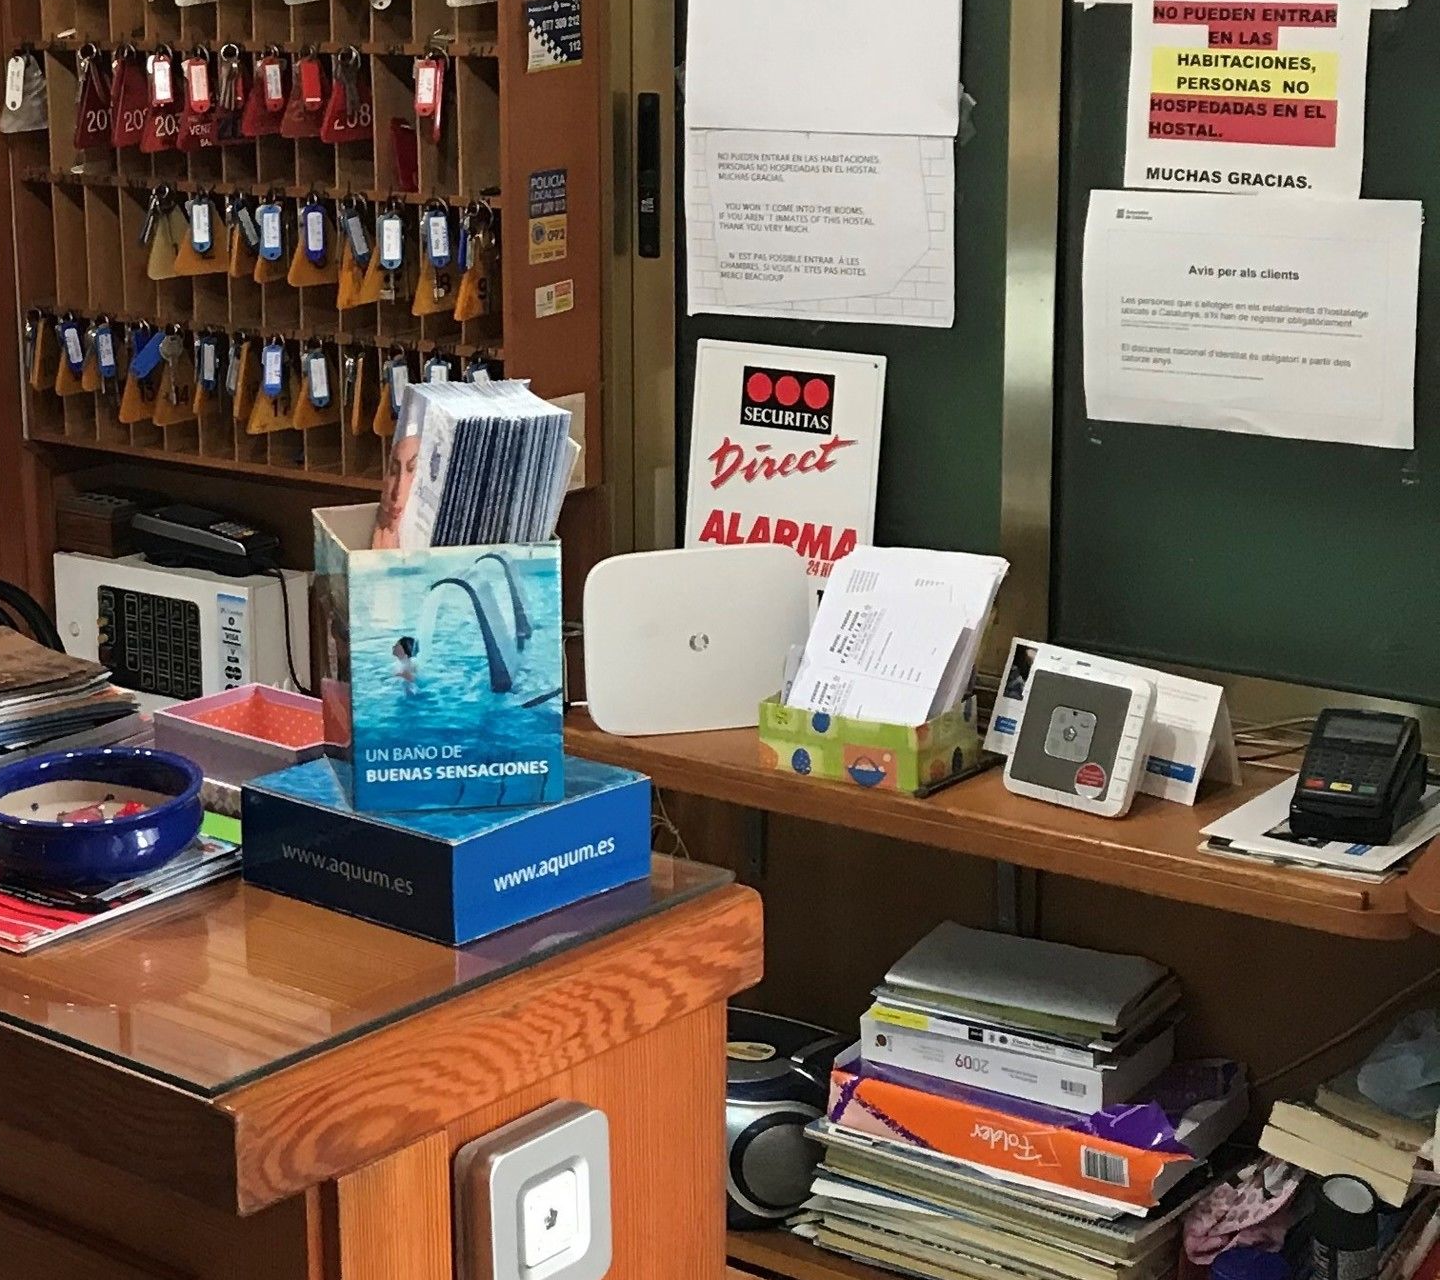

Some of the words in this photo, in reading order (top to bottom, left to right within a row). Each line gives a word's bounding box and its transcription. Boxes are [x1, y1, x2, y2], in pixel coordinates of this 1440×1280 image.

[1154, 6, 1177, 19] NO
[1184, 7, 1256, 21] PUEDEN
[1262, 9, 1336, 23] ENTRAR
[569, 40, 581, 52] 112
[1209, 32, 1233, 44] EN
[1240, 32, 1272, 45] LAS
[1178, 54, 1316, 73] HABITACIONES,
[1177, 77, 1270, 92] PERSONAS
[1283, 81, 1309, 93] NO
[1151, 99, 1266, 115] HOSPEDADAS
[1273, 105, 1297, 117] EN
[1304, 106, 1326, 118] EL
[1150, 122, 1222, 137] HOSTAL.
[718, 152, 729, 160] NO
[761, 153, 790, 161] ENTRAR
[792, 154, 802, 162] EN
[770, 164, 819, 172] HOSPEDADAS
[1146, 168, 1221, 183] MUCHAS
[1228, 172, 1312, 189] GRACIAS.
[772, 204, 793, 212] COME
[746, 223, 760, 231] YOU
[1189, 266, 1214, 275] Avis
[1218, 268, 1236, 278] per
[1240, 269, 1256, 278] als
[1260, 270, 1299, 280] clients
[744, 407, 829, 430] SECURITAS
[708, 434, 858, 490] Direct
[699, 509, 857, 561] ALARMA
[225, 633, 239, 642] VISA
[365, 748, 389, 762] UN
[393, 744, 438, 761] BAÑO
[441, 745, 462, 759] DE
[366, 766, 432, 783] BUENAS
[436, 761, 548, 780] SENSACIONES
[282, 841, 414, 896] www.aquum.es
[493, 835, 615, 893] www.aquum.es
[954, 1052, 990, 1074] 2009
[970, 1123, 1042, 1162] Folder
